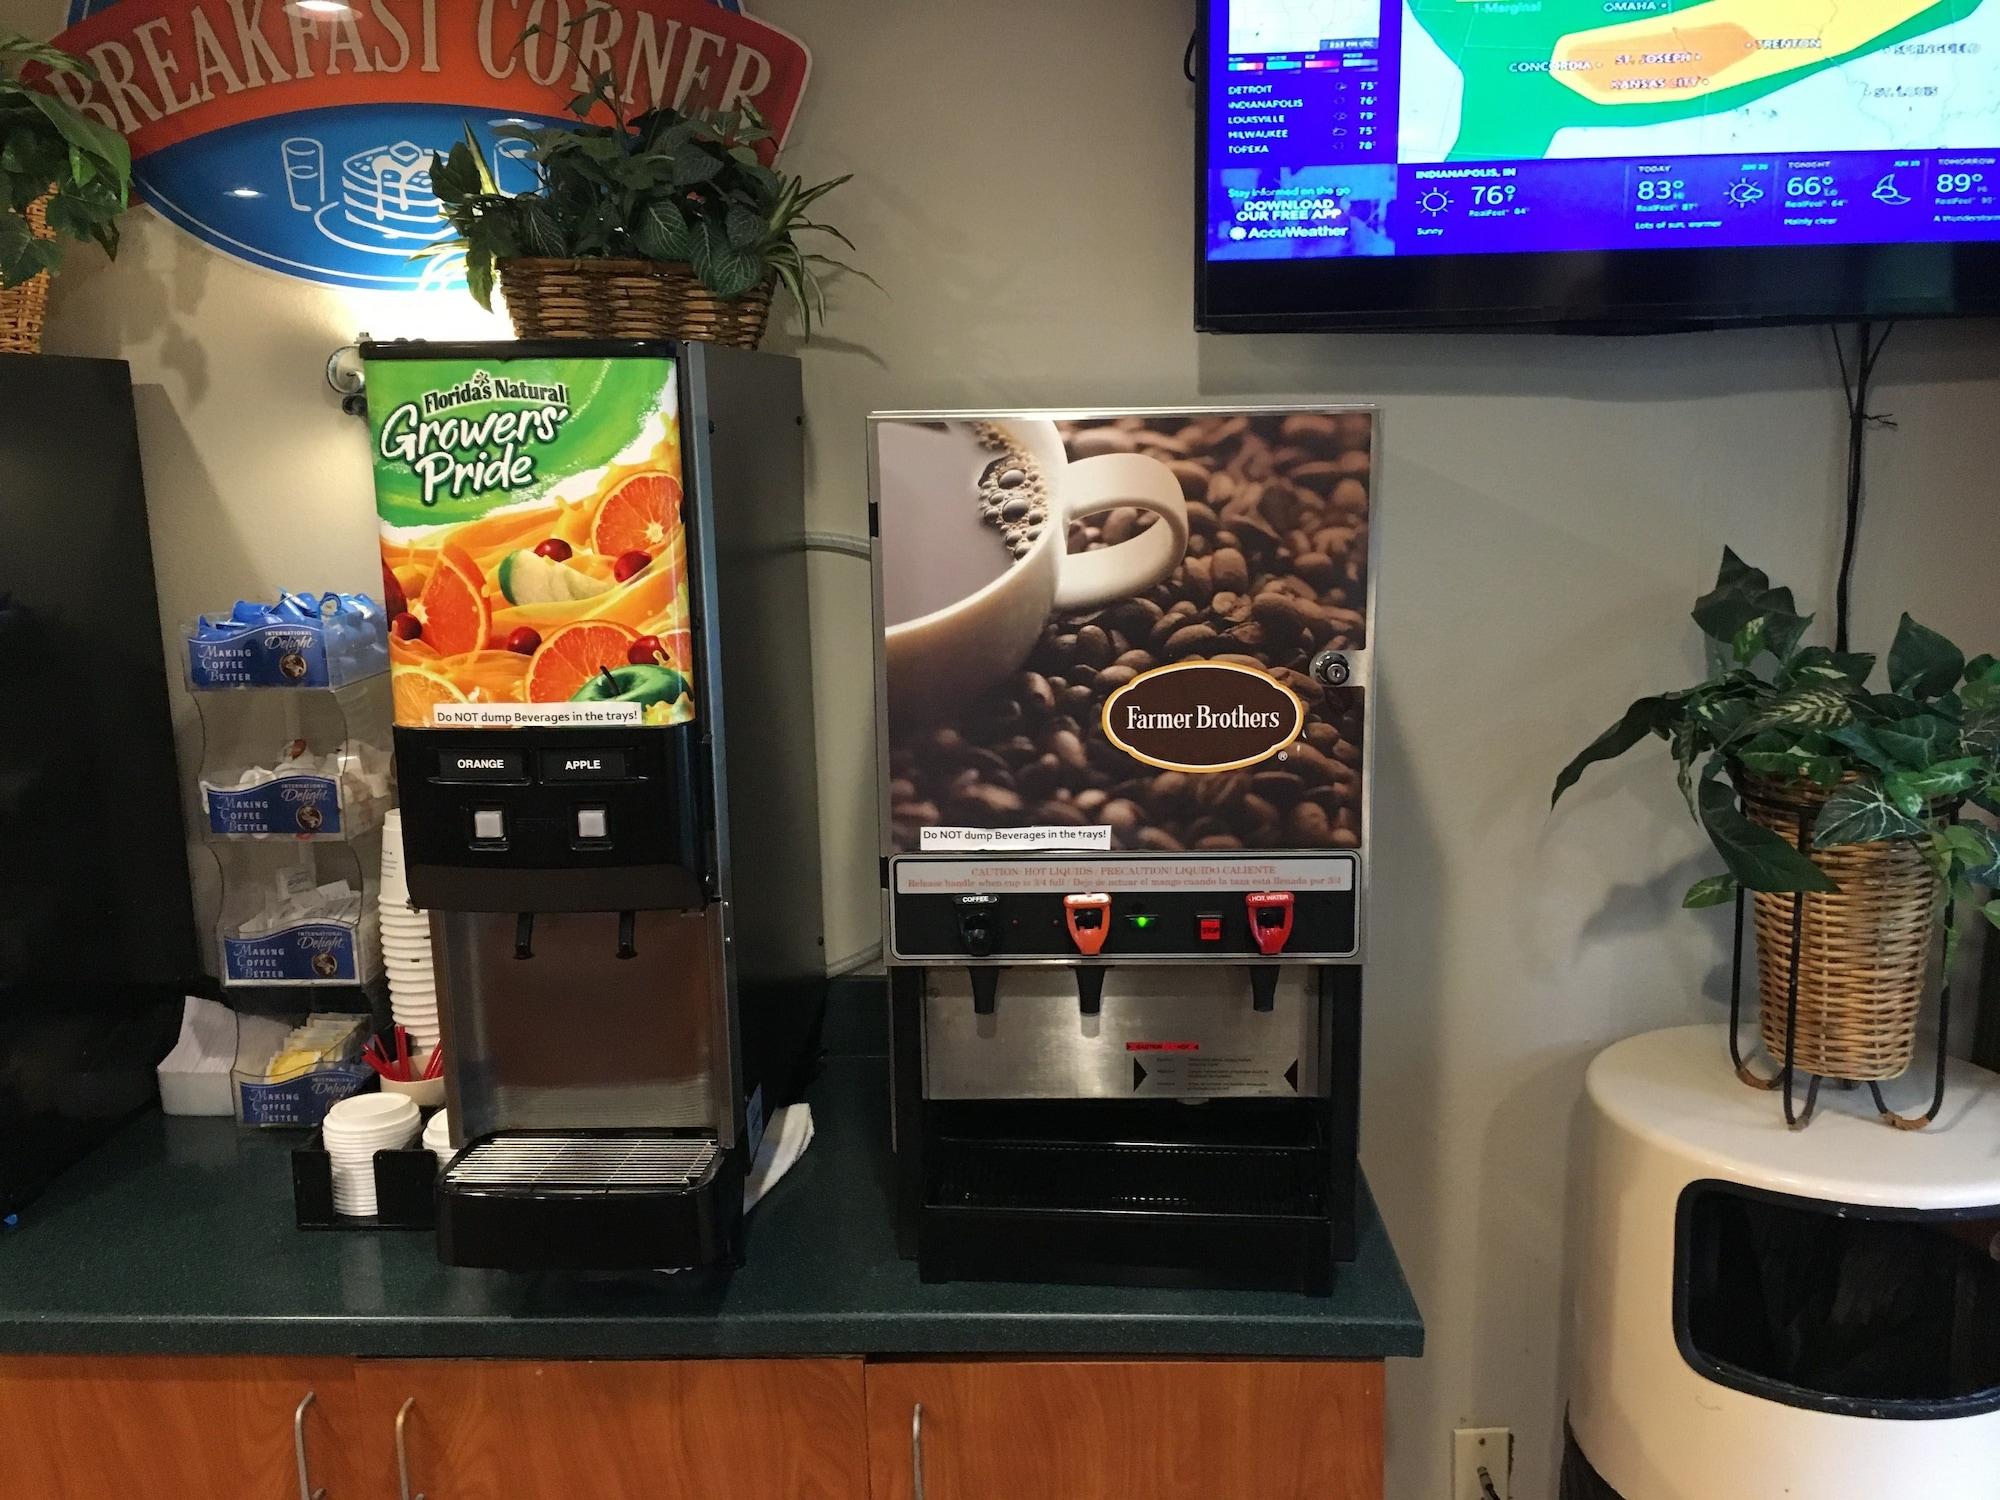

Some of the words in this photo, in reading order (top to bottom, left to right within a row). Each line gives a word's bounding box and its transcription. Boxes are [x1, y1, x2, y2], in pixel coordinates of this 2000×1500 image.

[1603, 2, 1656, 12] OMAHA
[1756, 38, 1821, 49] TRENTON
[1641, 53, 1691, 64] JOSEPH
[46, 0, 439, 134] BREAKFAST
[477, 0, 772, 133] CORNER
[1508, 61, 1592, 72] CONCORDIA
[1610, 78, 1665, 89] KANSAS
[1228, 85, 1273, 95] DETROIT
[1228, 99, 1304, 109] INDIANAPOLIS
[1228, 114, 1285, 125] LOUISVILLE
[1228, 129, 1289, 139] MILWAUKEE
[1228, 145, 1270, 154] TOPEKA
[1787, 161, 1831, 169] TONIGHT
[1937, 158, 1996, 166] TOMORROW
[1415, 169, 1501, 179] INDIANAPOLIS,
[1502, 167, 1517, 177] IN
[1638, 165, 1672, 173] TODAY
[1228, 188, 1250, 199] Stay
[1251, 187, 1299, 197] informed
[1316, 186, 1334, 195] the
[1335, 187, 1351, 196] go
[1243, 199, 1335, 212] DOWNLOAD
[1235, 211, 1269, 222] OUR
[1271, 210, 1309, 220] FREE
[1311, 208, 1342, 220] APP
[1635, 222, 1654, 230] Lots
[1248, 225, 1349, 239] AccuWeather
[1416, 228, 1444, 236] Sunny
[414, 443, 533, 504] Pride
[264, 635, 317, 654] Delight
[437, 712, 452, 722] Do
[454, 712, 479, 722] NOT
[481, 711, 512, 723] dump
[514, 711, 570, 725] Beverages
[572, 711, 583, 721] in
[584, 710, 604, 721] the
[605, 710, 638, 722] trays!
[1126, 705, 1193, 731] Farmer
[1196, 705, 1280, 730] Brothers
[457, 758, 504, 769] ORANGE
[565, 759, 601, 770] APPLE
[281, 788, 329, 806] Delight
[923, 830, 937, 839] Do
[940, 831, 962, 839] NOT
[964, 830, 993, 842] dump
[995, 830, 1046, 841] Beverages
[1048, 830, 1057, 839] in
[1059, 829, 1075, 839] the
[1077, 829, 1107, 840] trays!
[1024, 867, 1047, 876] HOT
[1050, 867, 1093, 878] LIQUIDS
[1174, 866, 1220, 877] LIQUIDO
[1223, 866, 1276, 875] CALIENTE
[908, 879, 942, 888] Release
[944, 879, 976, 888] handle
[978, 880, 1001, 888] when
[1003, 880, 1019, 889] cup
[1049, 879, 1065, 888] full
[1108, 878, 1138, 887] actuar
[1140, 878, 1148, 887] el
[1151, 879, 1182, 888] mango
[1184, 878, 1217, 887] cuando
[1310, 878, 1326, 887] por
[297, 936, 344, 954] Delight
